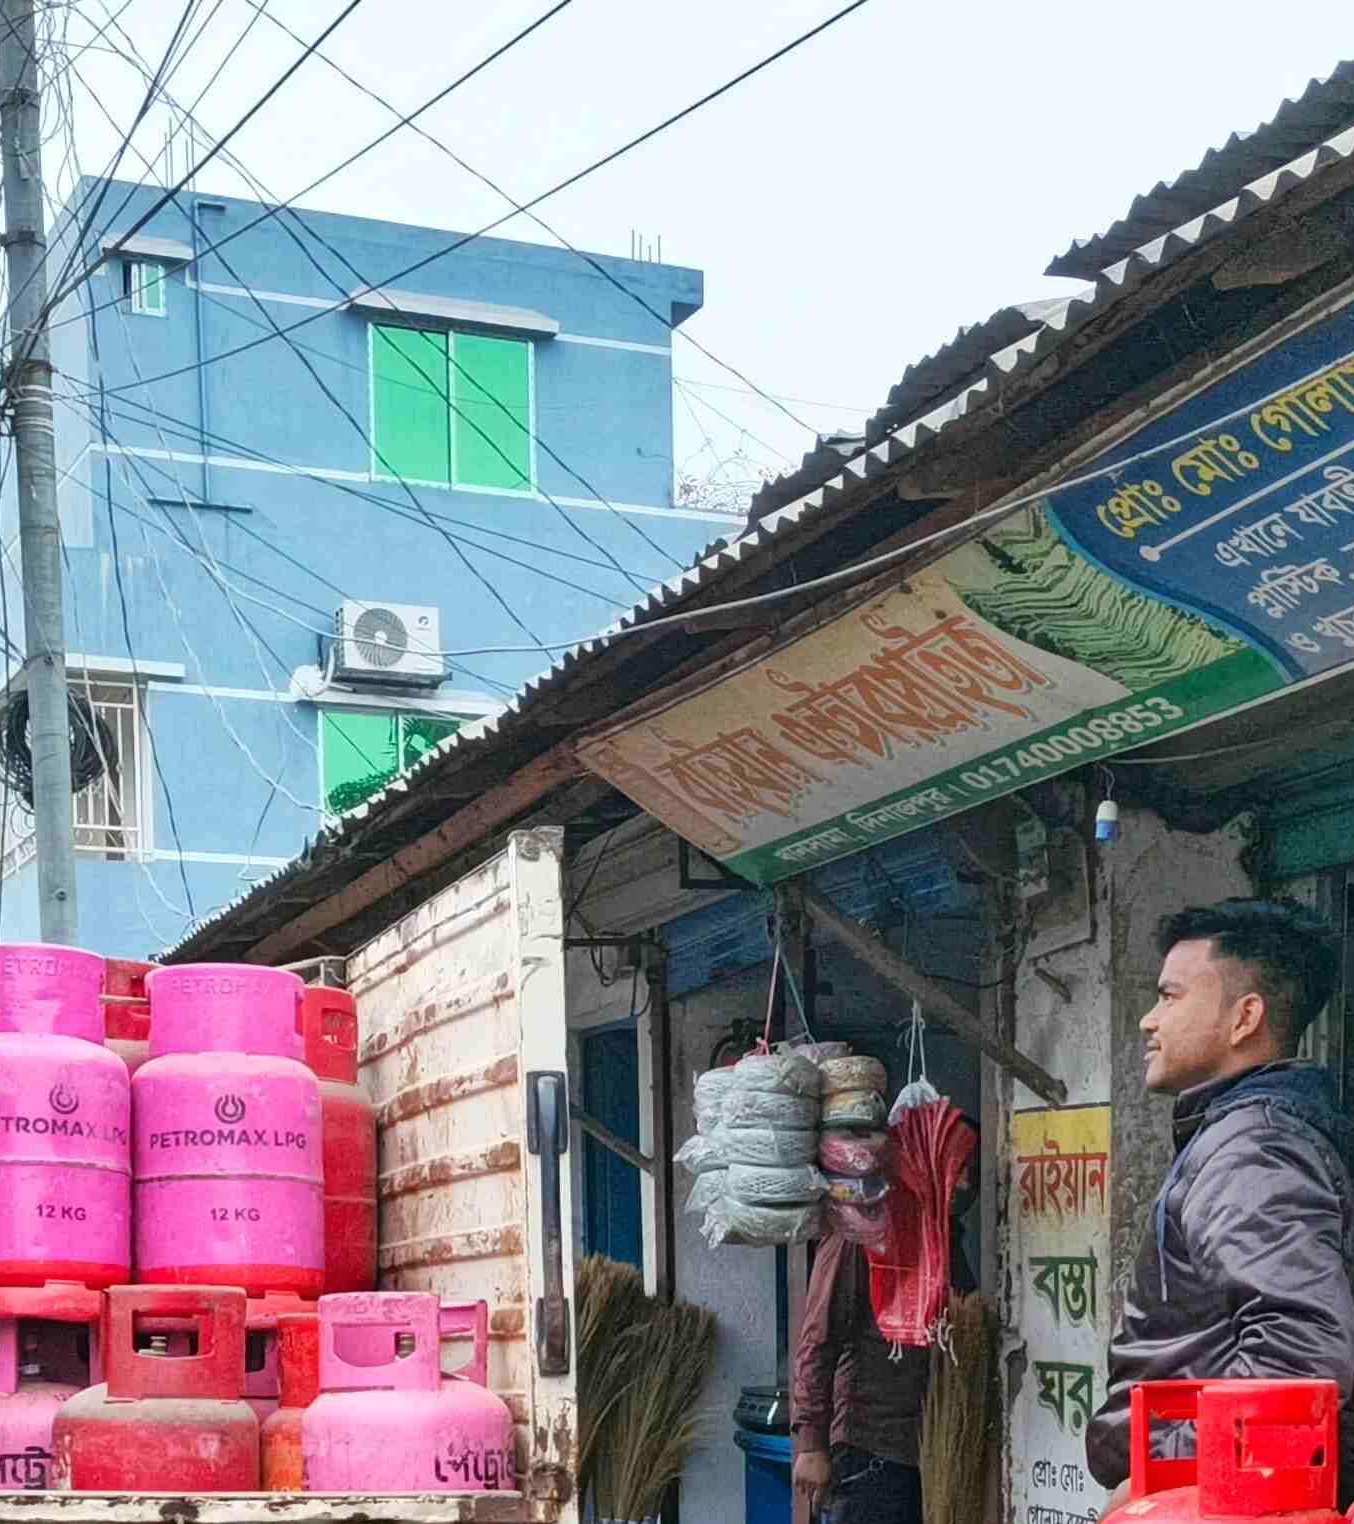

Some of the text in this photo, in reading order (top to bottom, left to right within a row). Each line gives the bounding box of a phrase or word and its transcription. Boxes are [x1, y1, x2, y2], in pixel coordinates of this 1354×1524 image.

[1096, 477, 1182, 541] প্রোঃ
[1171, 431, 1259, 497] মোঃ
[1213, 513, 1289, 570] এখানে
[962, 695, 1186, 792] 01740008853
[149, 1128, 307, 1150] PETROMAX LPG
[35, 1203, 87, 1222] 12 KG
[210, 1206, 262, 1223] 12 KG
[1015, 1138, 1109, 1220] রাইয়ান
[1028, 1245, 1100, 1330] বস্তা
[1030, 1359, 1095, 1435] ঘর
